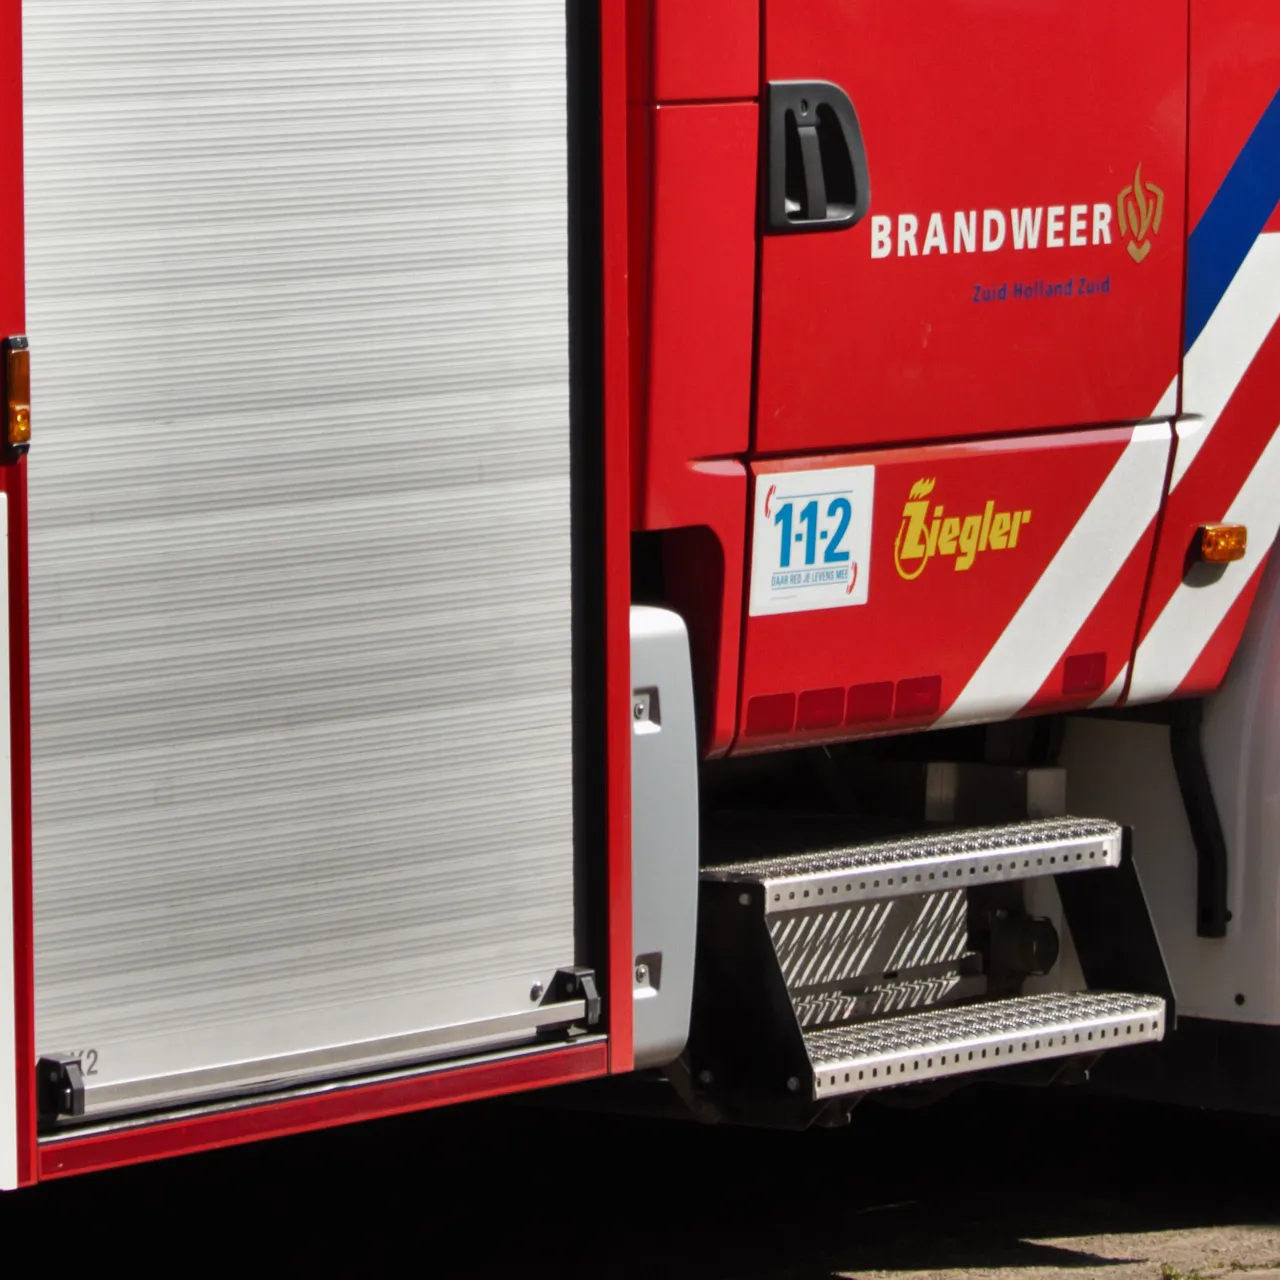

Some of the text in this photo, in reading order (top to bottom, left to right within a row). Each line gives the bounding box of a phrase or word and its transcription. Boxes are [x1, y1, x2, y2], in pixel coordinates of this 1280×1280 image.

[871, 203, 1112, 259] BRANDWEER
[1077, 274, 1111, 296] Zuid
[894, 482, 1031, 580] Ziegler
[771, 569, 849, 587] DAAR RED JE LEVENS MEE
